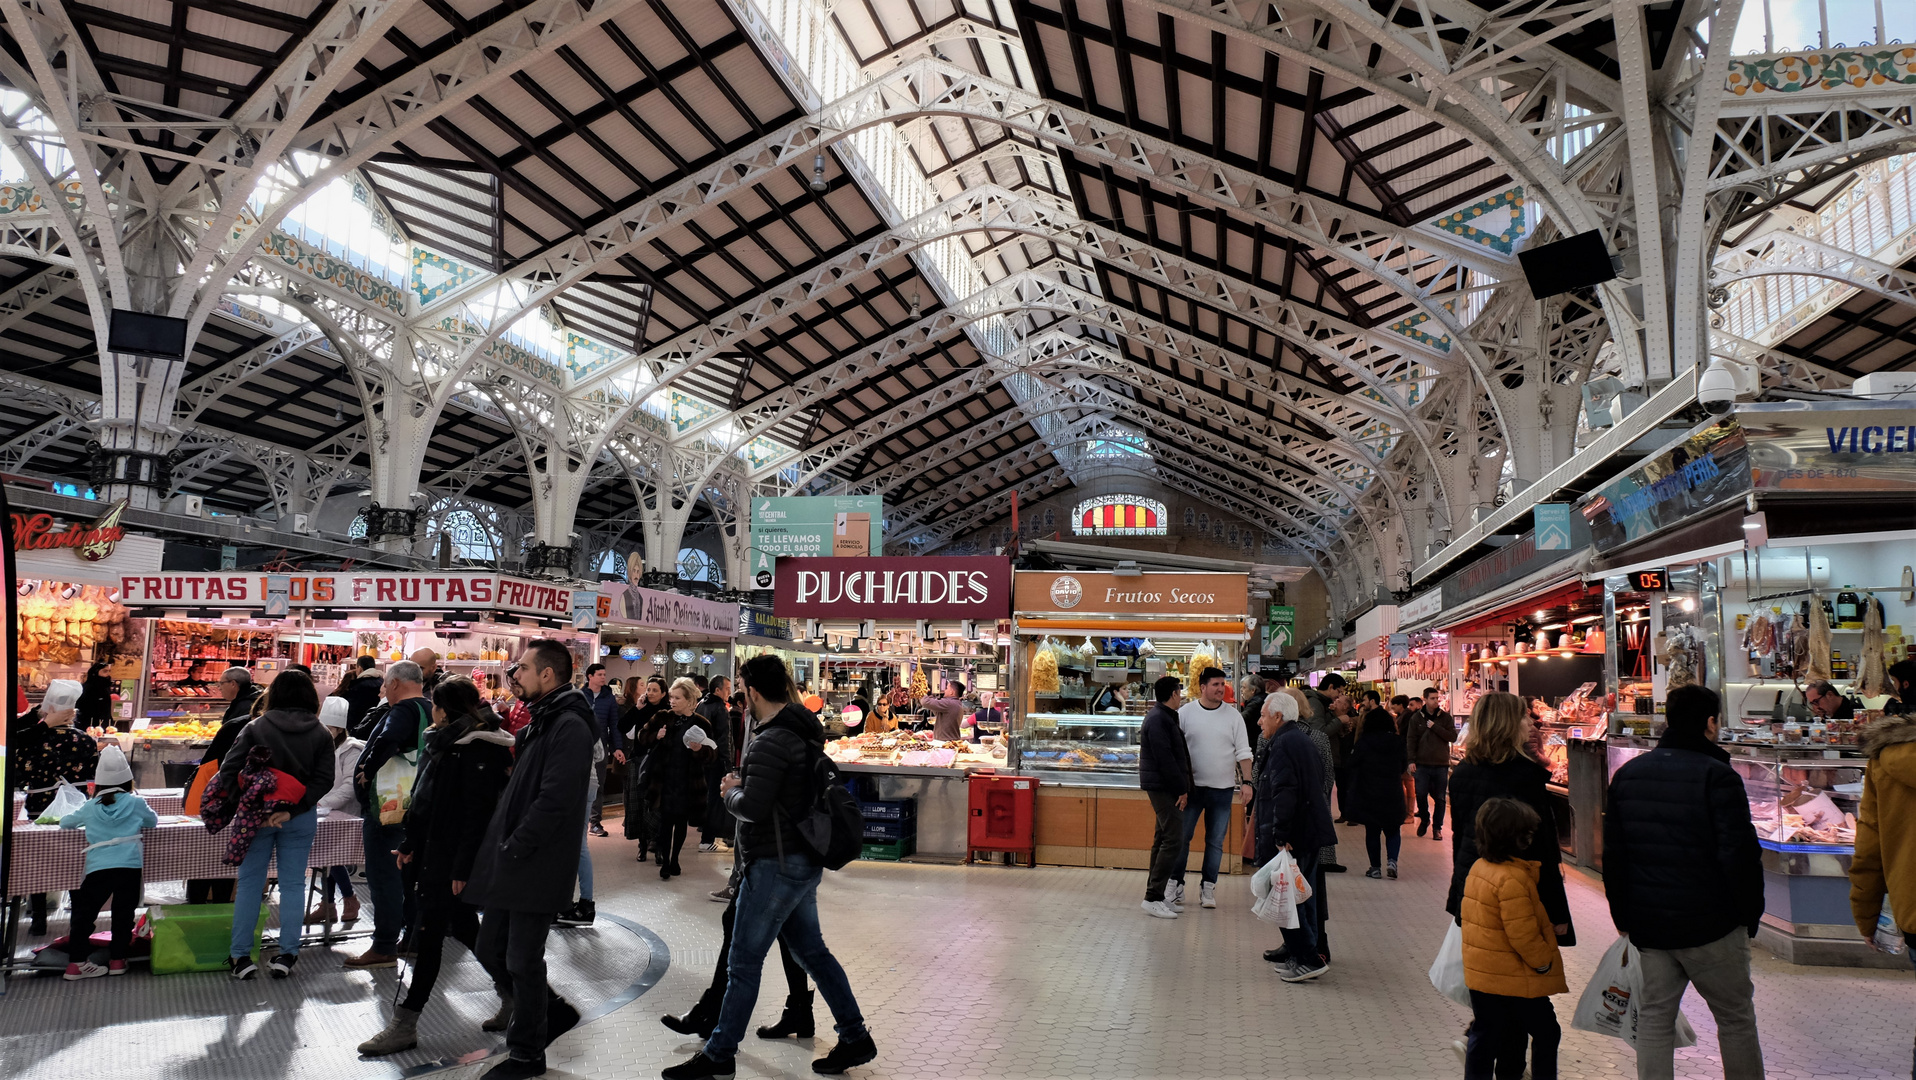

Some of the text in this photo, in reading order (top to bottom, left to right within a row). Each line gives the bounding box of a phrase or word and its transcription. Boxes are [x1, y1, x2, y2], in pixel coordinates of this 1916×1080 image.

[1684, 452, 1720, 489] PERIS
[1808, 469, 1825, 479] DE
[1831, 469, 1857, 478] 1870
[758, 535, 821, 544] TE LLEVAMOS
[758, 553, 769, 568] A
[1511, 539, 1536, 568] JAMO
[121, 577, 247, 600] FRUTAS
[352, 577, 492, 602] FRUTAS
[796, 570, 989, 605] PUCHADES
[1640, 573, 1661, 588] 05
[498, 580, 570, 612] FRUTAS
[1104, 587, 1215, 604] Frutos Secos
